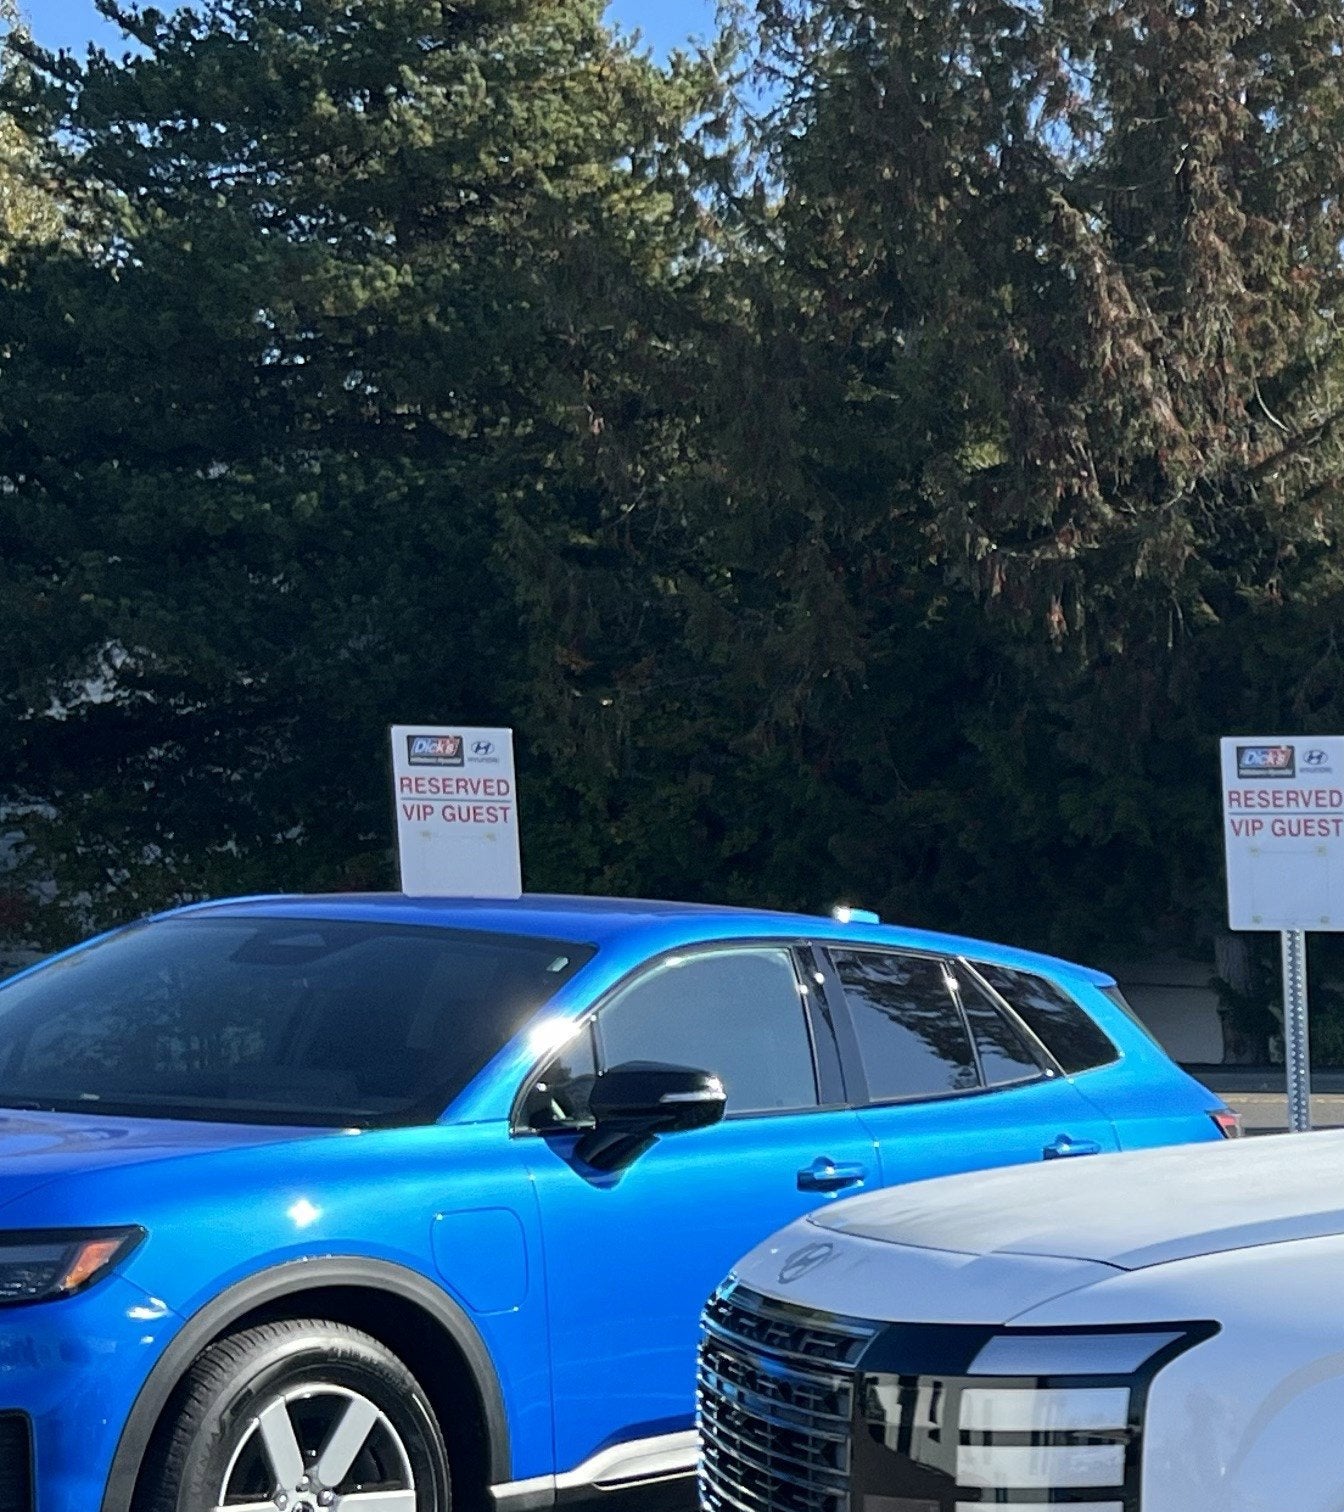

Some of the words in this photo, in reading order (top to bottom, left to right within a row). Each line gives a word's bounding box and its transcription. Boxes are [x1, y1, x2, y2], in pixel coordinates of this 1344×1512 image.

[400, 777, 509, 796] RESERVED
[1228, 790, 1343, 808] RESERVED
[403, 804, 434, 821] VIP
[442, 805, 510, 823] GUEST
[1230, 818, 1264, 836] VIP
[1271, 818, 1343, 837] GUEST
